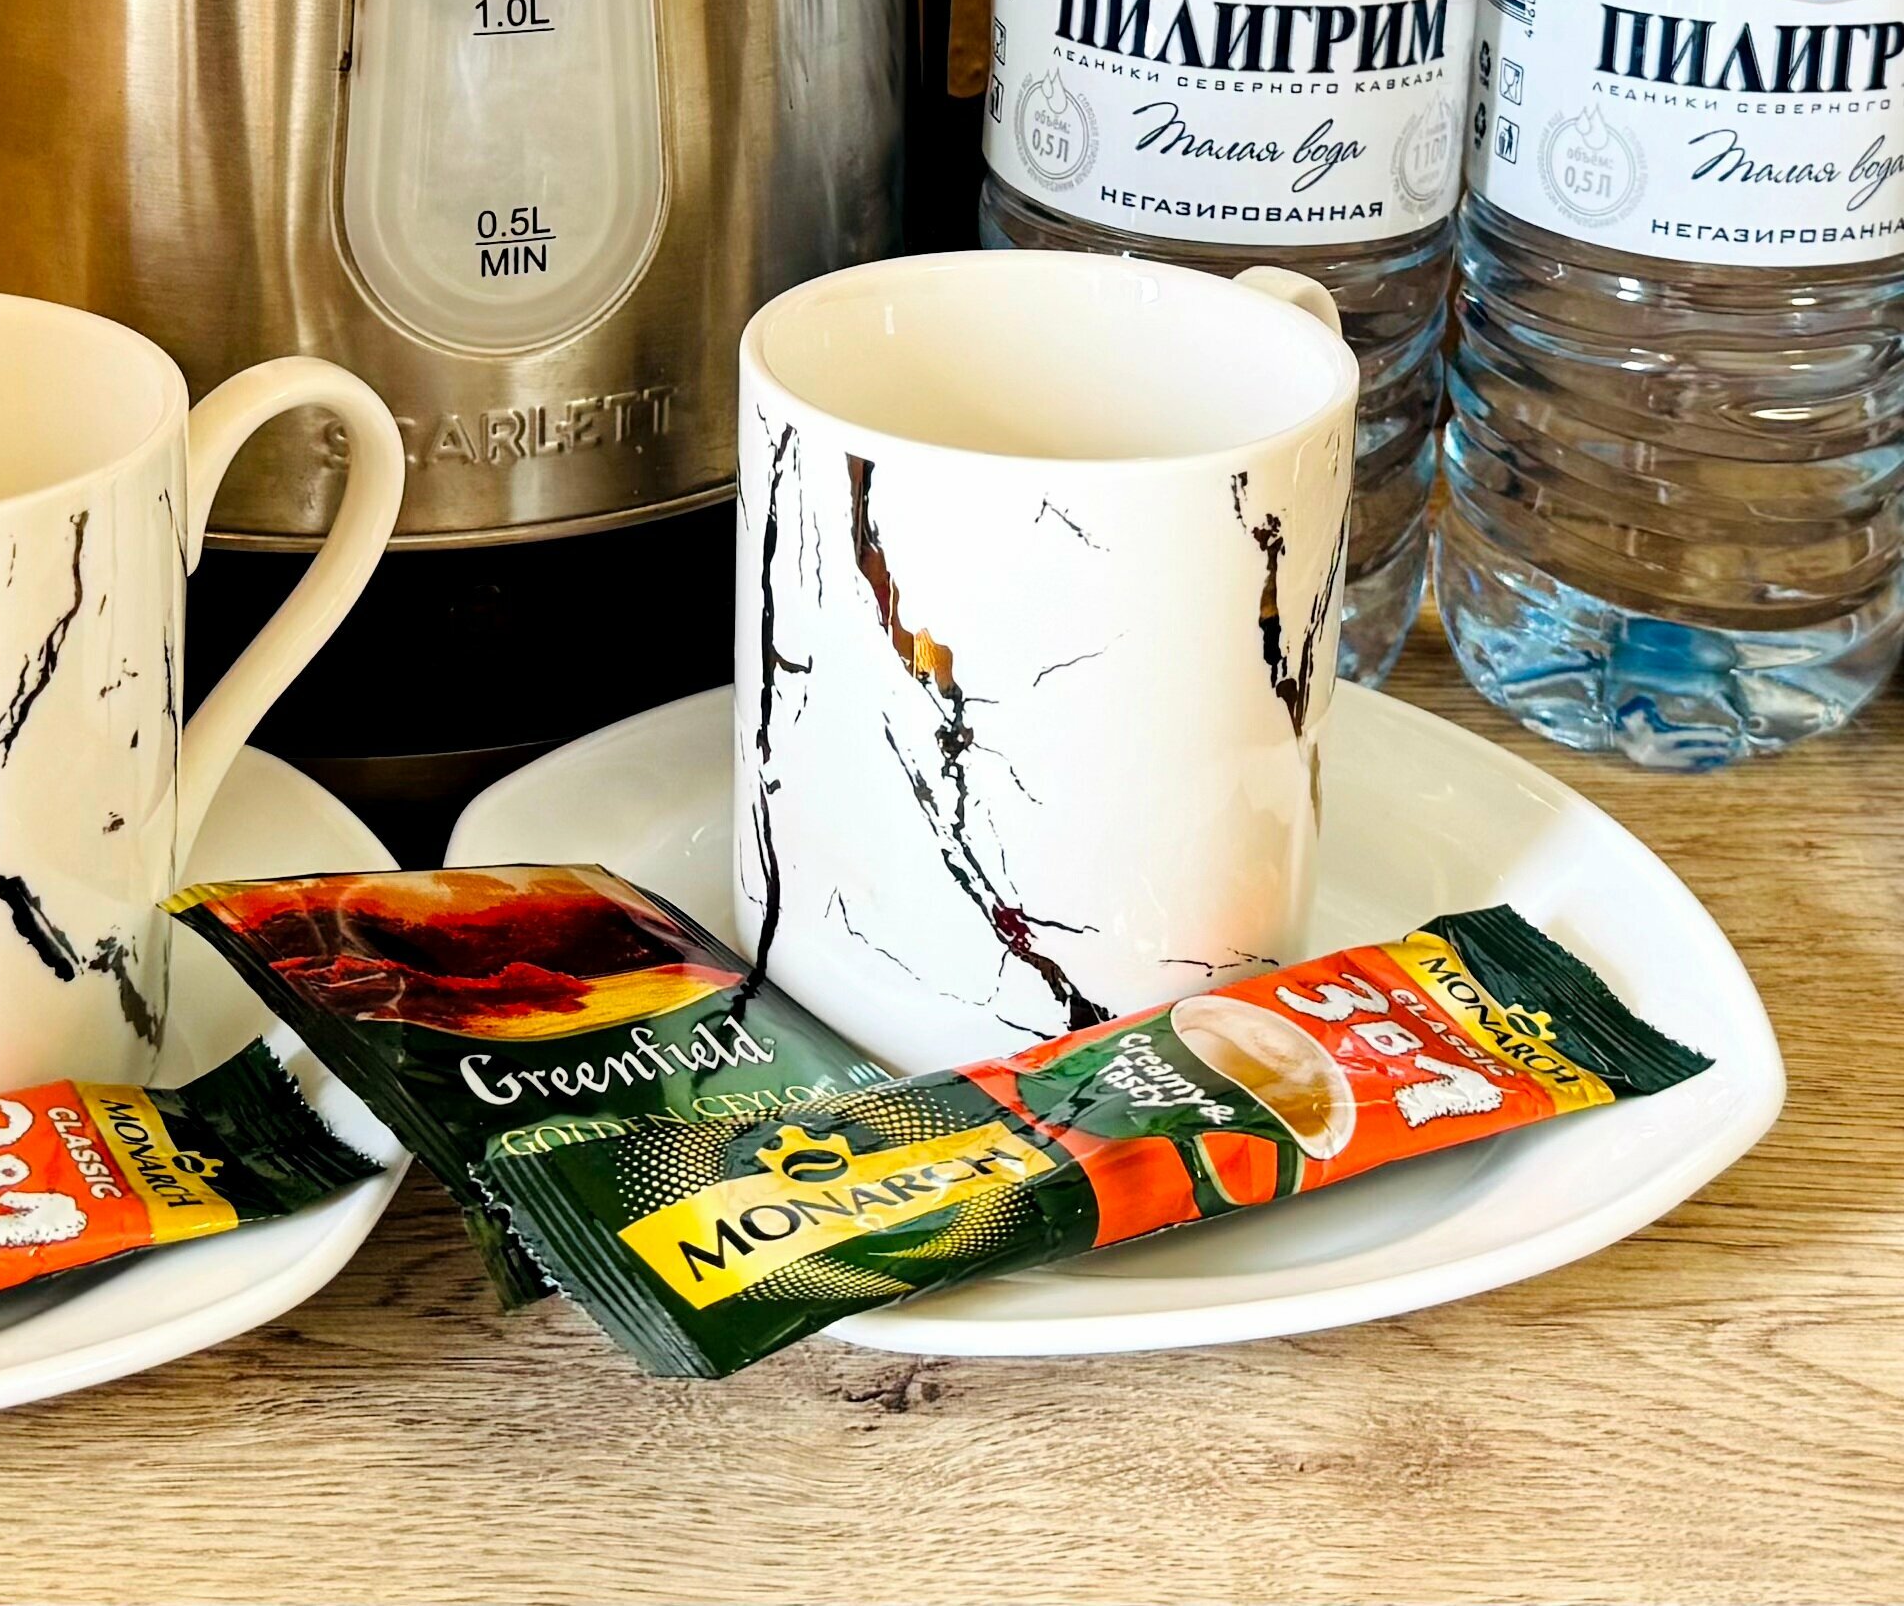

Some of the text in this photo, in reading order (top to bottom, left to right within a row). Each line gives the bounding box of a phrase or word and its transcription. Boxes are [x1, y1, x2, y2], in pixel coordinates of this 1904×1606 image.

[1052, 45, 1444, 94] ЛЕДНИКИ СЕВЕРНОГО КАВКАЗА
[1591, 81, 1718, 111] ЛЕДНИКИ
[1736, 97, 1891, 115] СЕВЕРНОГО
[1132, 102, 1286, 162] Талая
[1292, 117, 1367, 193] вода
[1687, 128, 1842, 184] Талая
[476, 206, 552, 239] 0.5L
[1100, 185, 1384, 223] НЕГАЗИРОВАННАЯ
[479, 242, 549, 277] MIN
[458, 1014, 776, 1106] Greenfield
[1389, 987, 1517, 1078] CLASSIC
[1417, 955, 1582, 1085] MONARCH
[1096, 1054, 1175, 1108] Tasty
[1118, 1032, 1235, 1125] Creamy &
[46, 1105, 124, 1199] CLASSIC
[99, 1098, 205, 1209] MONARCH
[677, 1146, 1025, 1283] MONARCH
